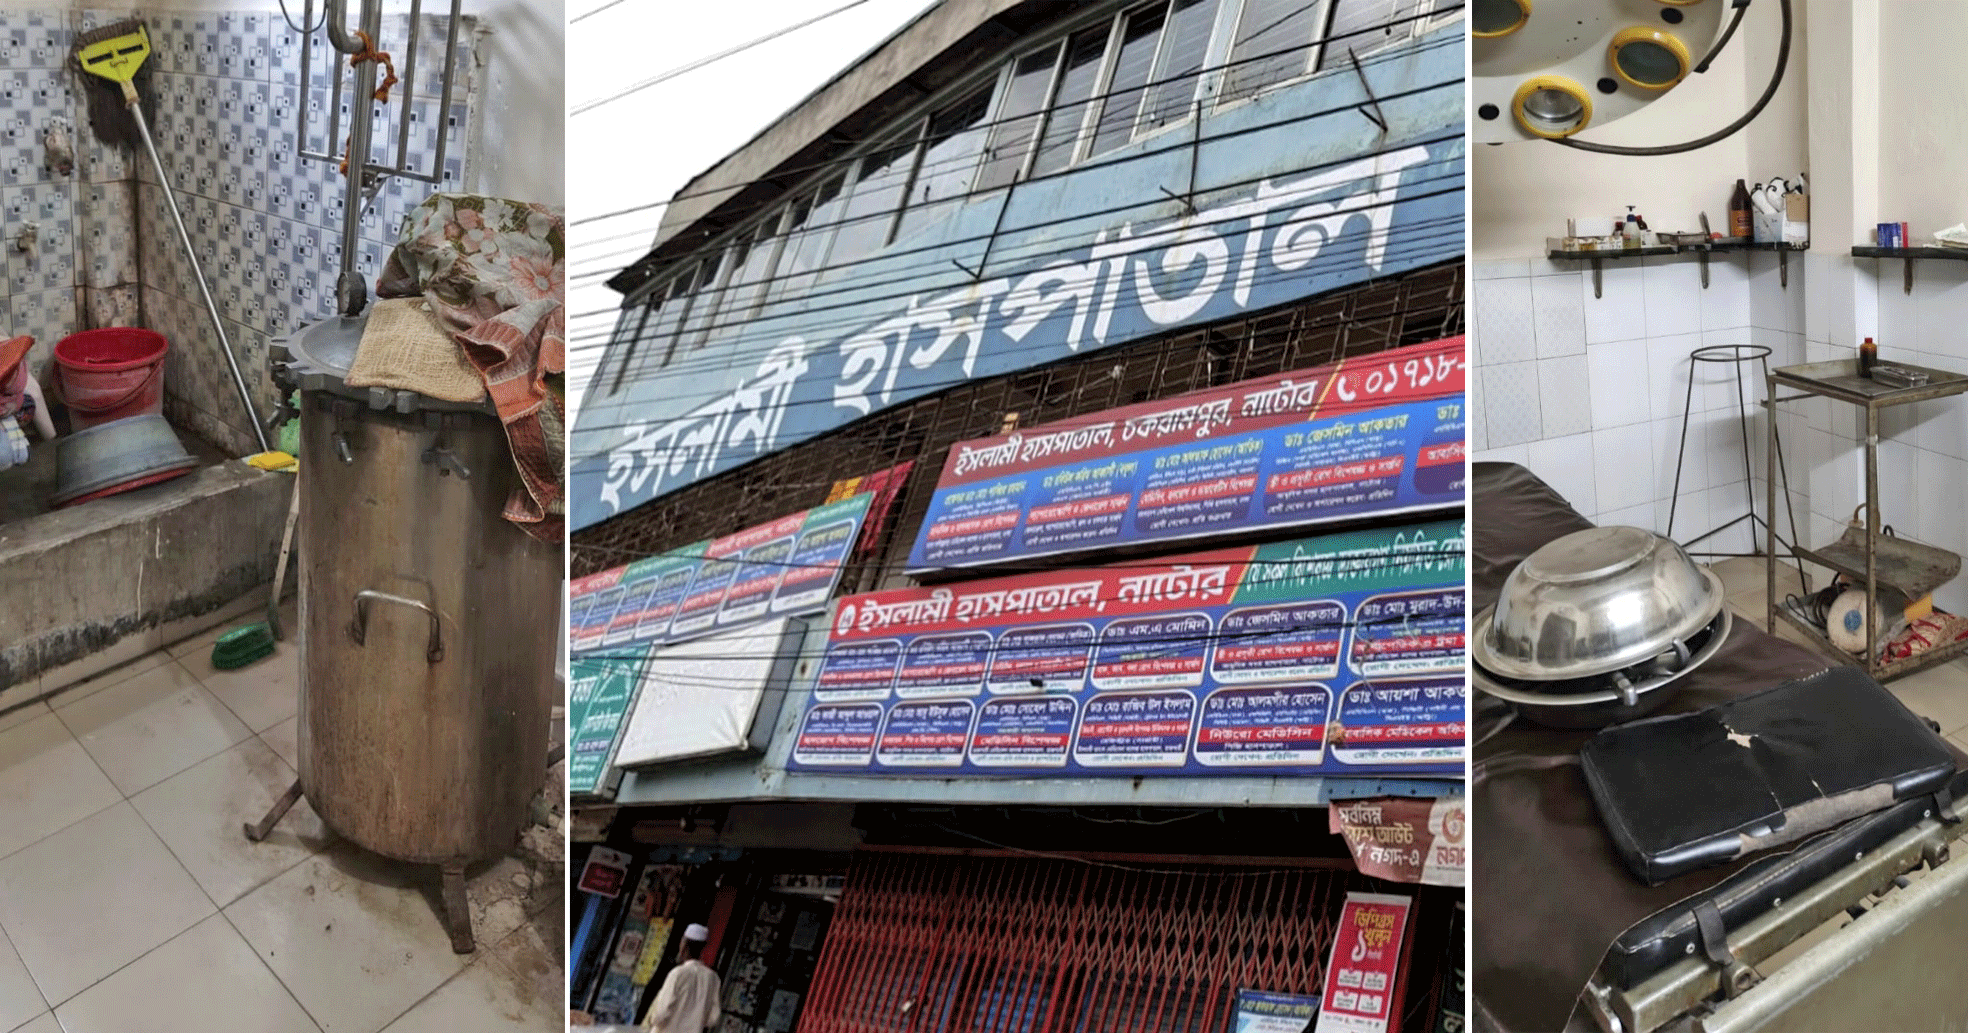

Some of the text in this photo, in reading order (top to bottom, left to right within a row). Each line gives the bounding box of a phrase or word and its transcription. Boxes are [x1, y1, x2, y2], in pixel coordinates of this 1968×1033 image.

[600, 145, 1428, 516] ইসলামী হাসপাতাল
[954, 432, 1023, 475] ইসলামী
[1241, 380, 1318, 416] নাটোর
[859, 565, 1230, 631] ইসলামী হাসপাতাল, নাটোর
[1349, 691, 1371, 704] ডাঃ
